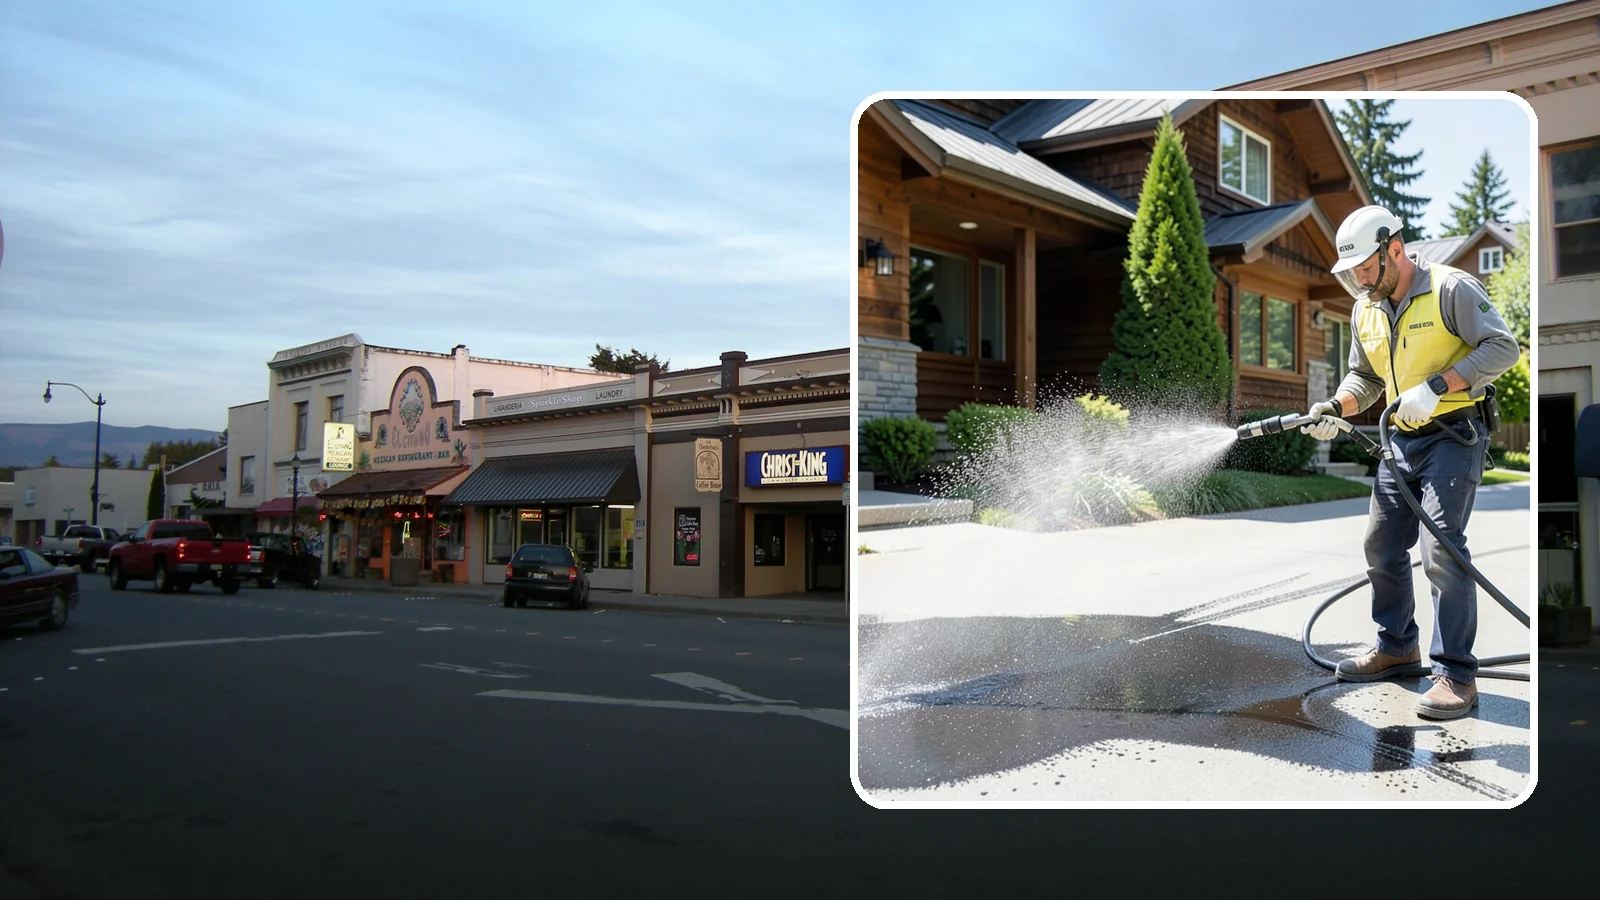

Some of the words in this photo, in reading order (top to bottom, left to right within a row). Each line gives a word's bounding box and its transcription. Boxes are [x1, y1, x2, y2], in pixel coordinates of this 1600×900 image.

[493, 402, 522, 412] LAVANDERIA
[531, 398, 560, 409] Sparkle
[562, 394, 582, 406] Shop
[595, 389, 623, 399] LAUNDRY
[373, 454, 396, 464] MEXICAN
[398, 451, 433, 462] RESTAURANT
[438, 450, 450, 459] BAR
[761, 452, 797, 478] CHRIST
[799, 450, 827, 476] KING
